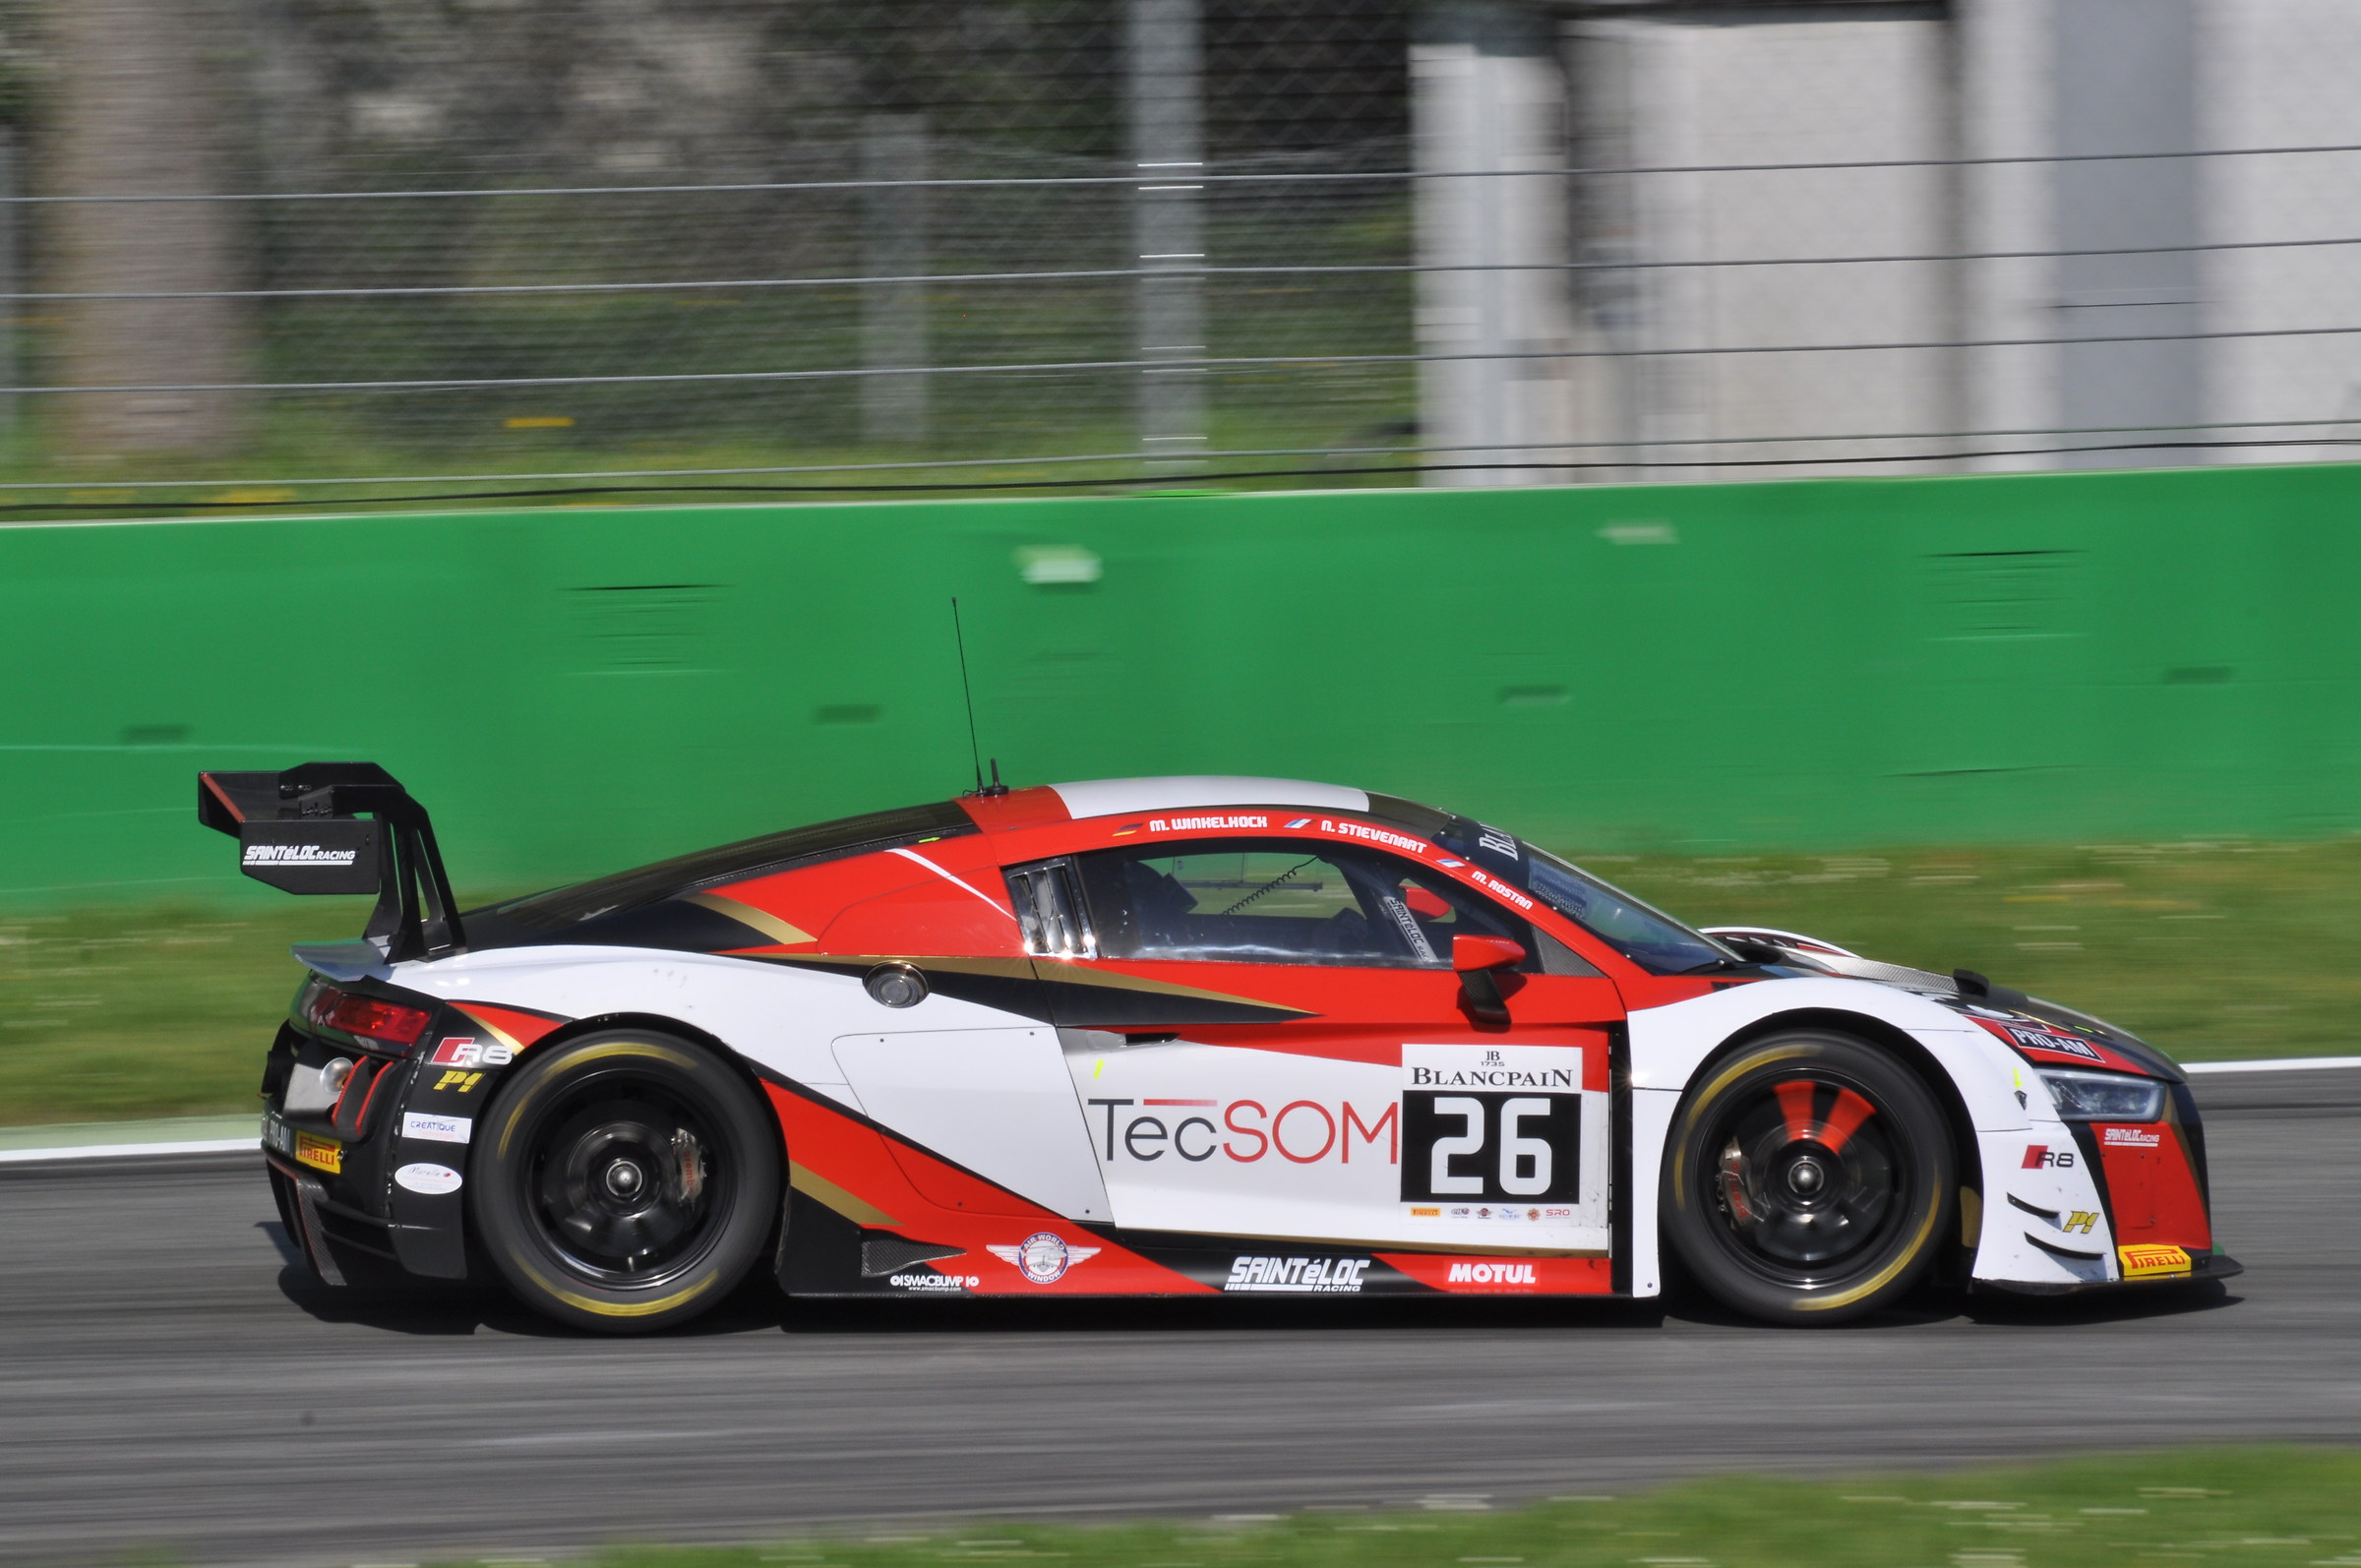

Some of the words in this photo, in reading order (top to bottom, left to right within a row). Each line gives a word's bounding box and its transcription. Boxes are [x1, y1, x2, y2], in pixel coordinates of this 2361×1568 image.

[1149, 819, 1170, 831] M.
[1171, 816, 1268, 830] WINKELHOCK
[1321, 819, 1336, 832] N.
[1338, 822, 1427, 854] STIEVENART
[316, 850, 356, 861] RACING
[1471, 871, 1487, 885] M.
[1487, 879, 1534, 911] ROSTAN
[2009, 1028, 2095, 1057] PRO-AM
[451, 1043, 514, 1065] R8
[1412, 1066, 1574, 1088] BLANCPAIN
[1087, 1098, 1399, 1165] TecSOM
[299, 1134, 336, 1166] PIRELLI
[1430, 1096, 1552, 1196] 26
[2034, 1151, 2075, 1168] R8
[1545, 1208, 1571, 1217] SRO
[1023, 1236, 1037, 1250] AIR
[1037, 1234, 1065, 1251] WORLD
[2124, 1248, 2186, 1270] PIRELLI
[1027, 1269, 1061, 1283] WINDOW
[1448, 1263, 1537, 1285] MOTUL
